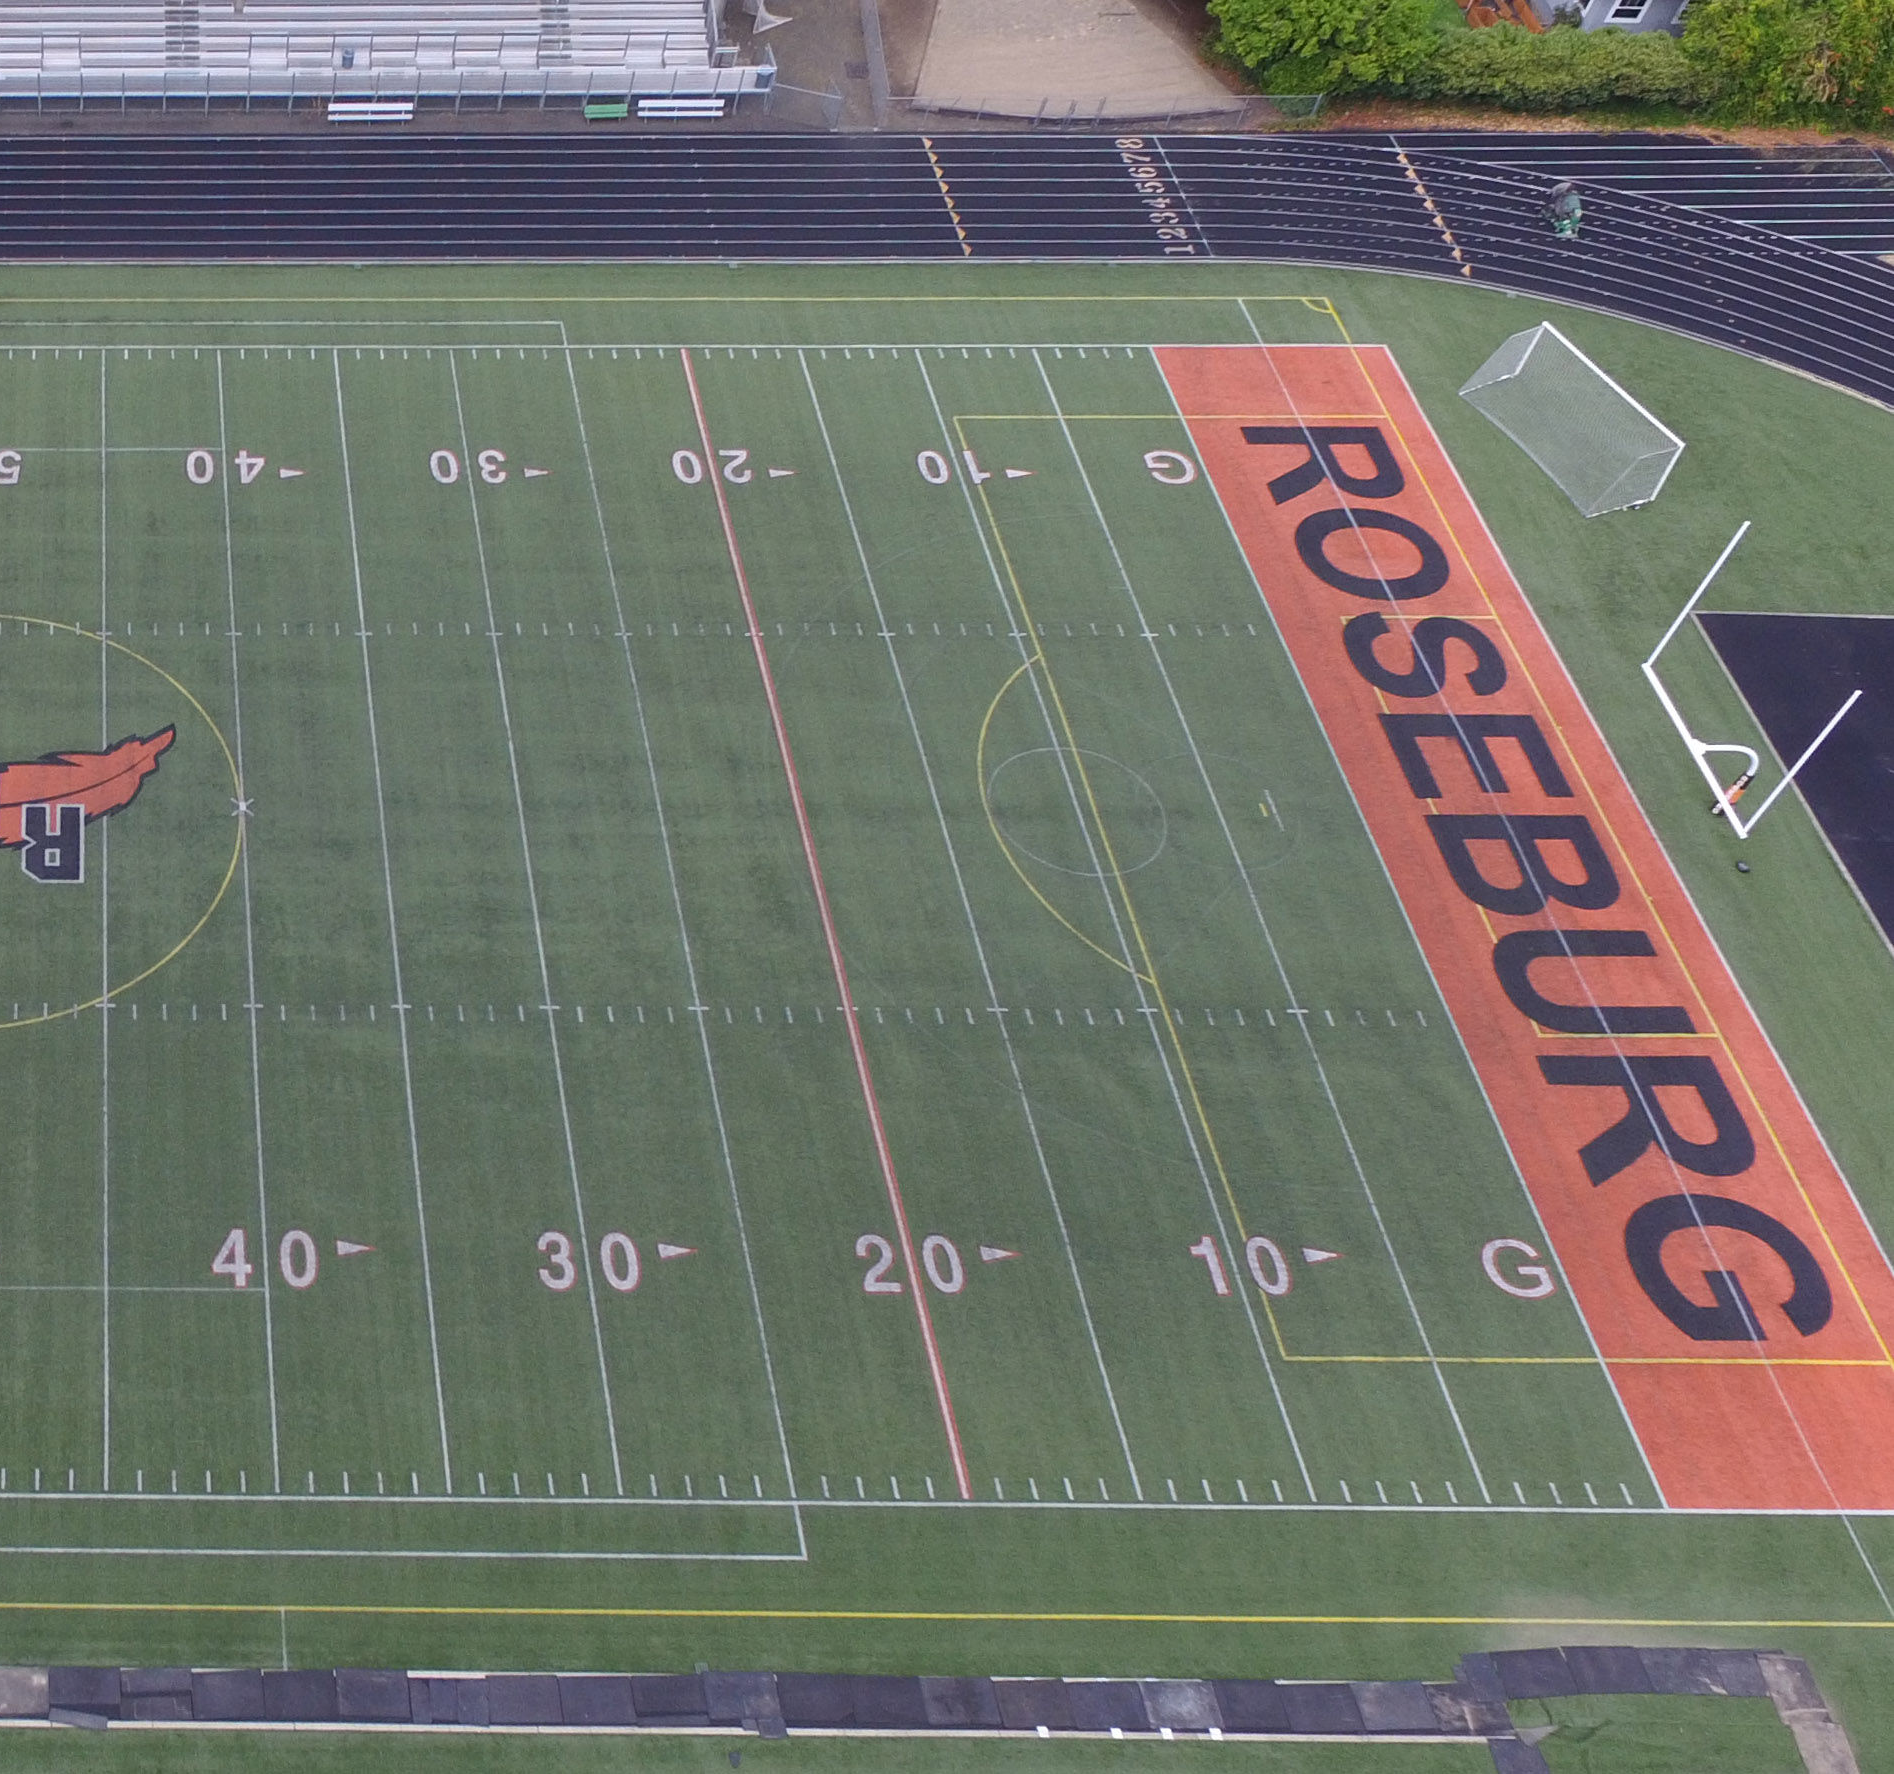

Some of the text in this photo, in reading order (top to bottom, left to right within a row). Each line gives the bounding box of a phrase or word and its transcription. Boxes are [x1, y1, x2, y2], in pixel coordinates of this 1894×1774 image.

[186, 449, 266, 485] 40
[429, 449, 508, 485] 30
[671, 449, 753, 485] 20
[917, 449, 992, 485] 10
[1144, 449, 1198, 486] G
[1240, 424, 1831, 1342] ROSEBURG
[211, 1228, 320, 1289] 40
[536, 1230, 641, 1292] 30
[855, 1233, 966, 1295] 20
[1188, 1235, 1293, 1298] 10
[1479, 1238, 1557, 1300] G
